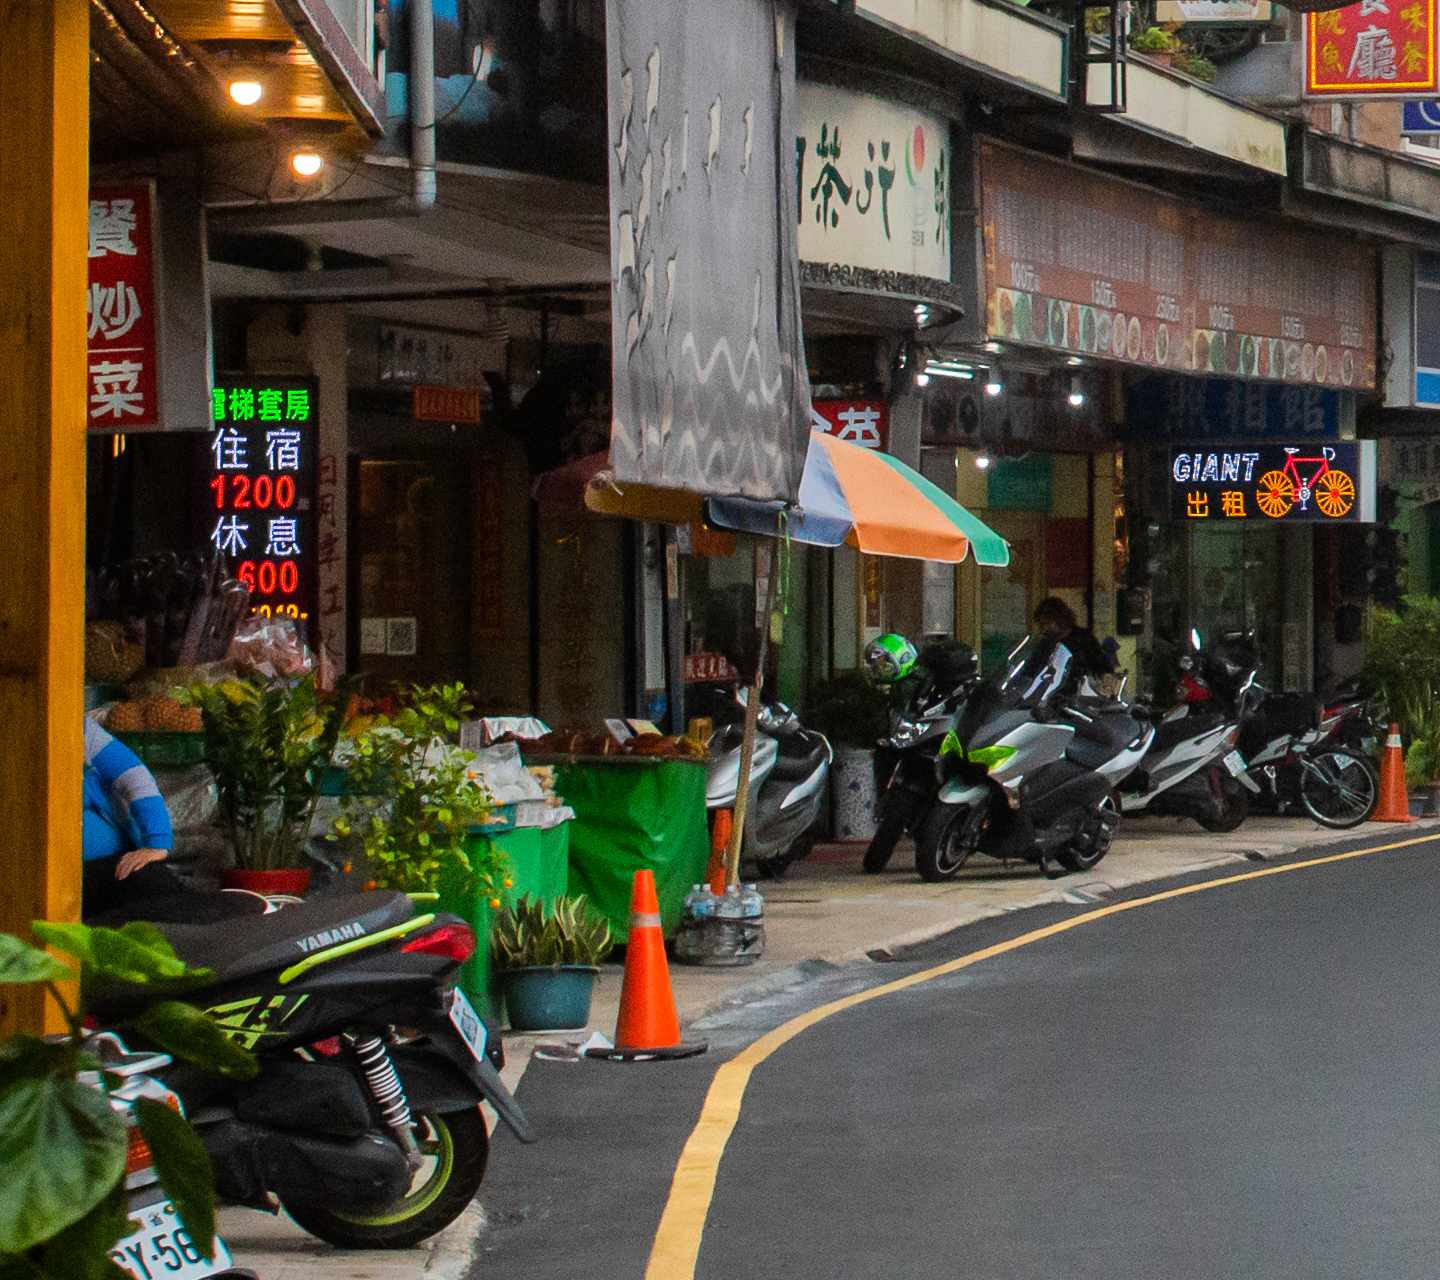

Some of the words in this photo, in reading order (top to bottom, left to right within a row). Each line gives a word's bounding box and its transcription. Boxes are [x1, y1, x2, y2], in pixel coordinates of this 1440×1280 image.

[796, 122, 895, 241] 茶行
[212, 428, 301, 470] 住宿
[1173, 452, 1259, 483] GIANT
[210, 475, 295, 509] 1200
[1187, 491, 1248, 518] 出租
[210, 515, 301, 556] 休息
[238, 560, 298, 594] 600
[296, 922, 367, 953] YAMAHA
